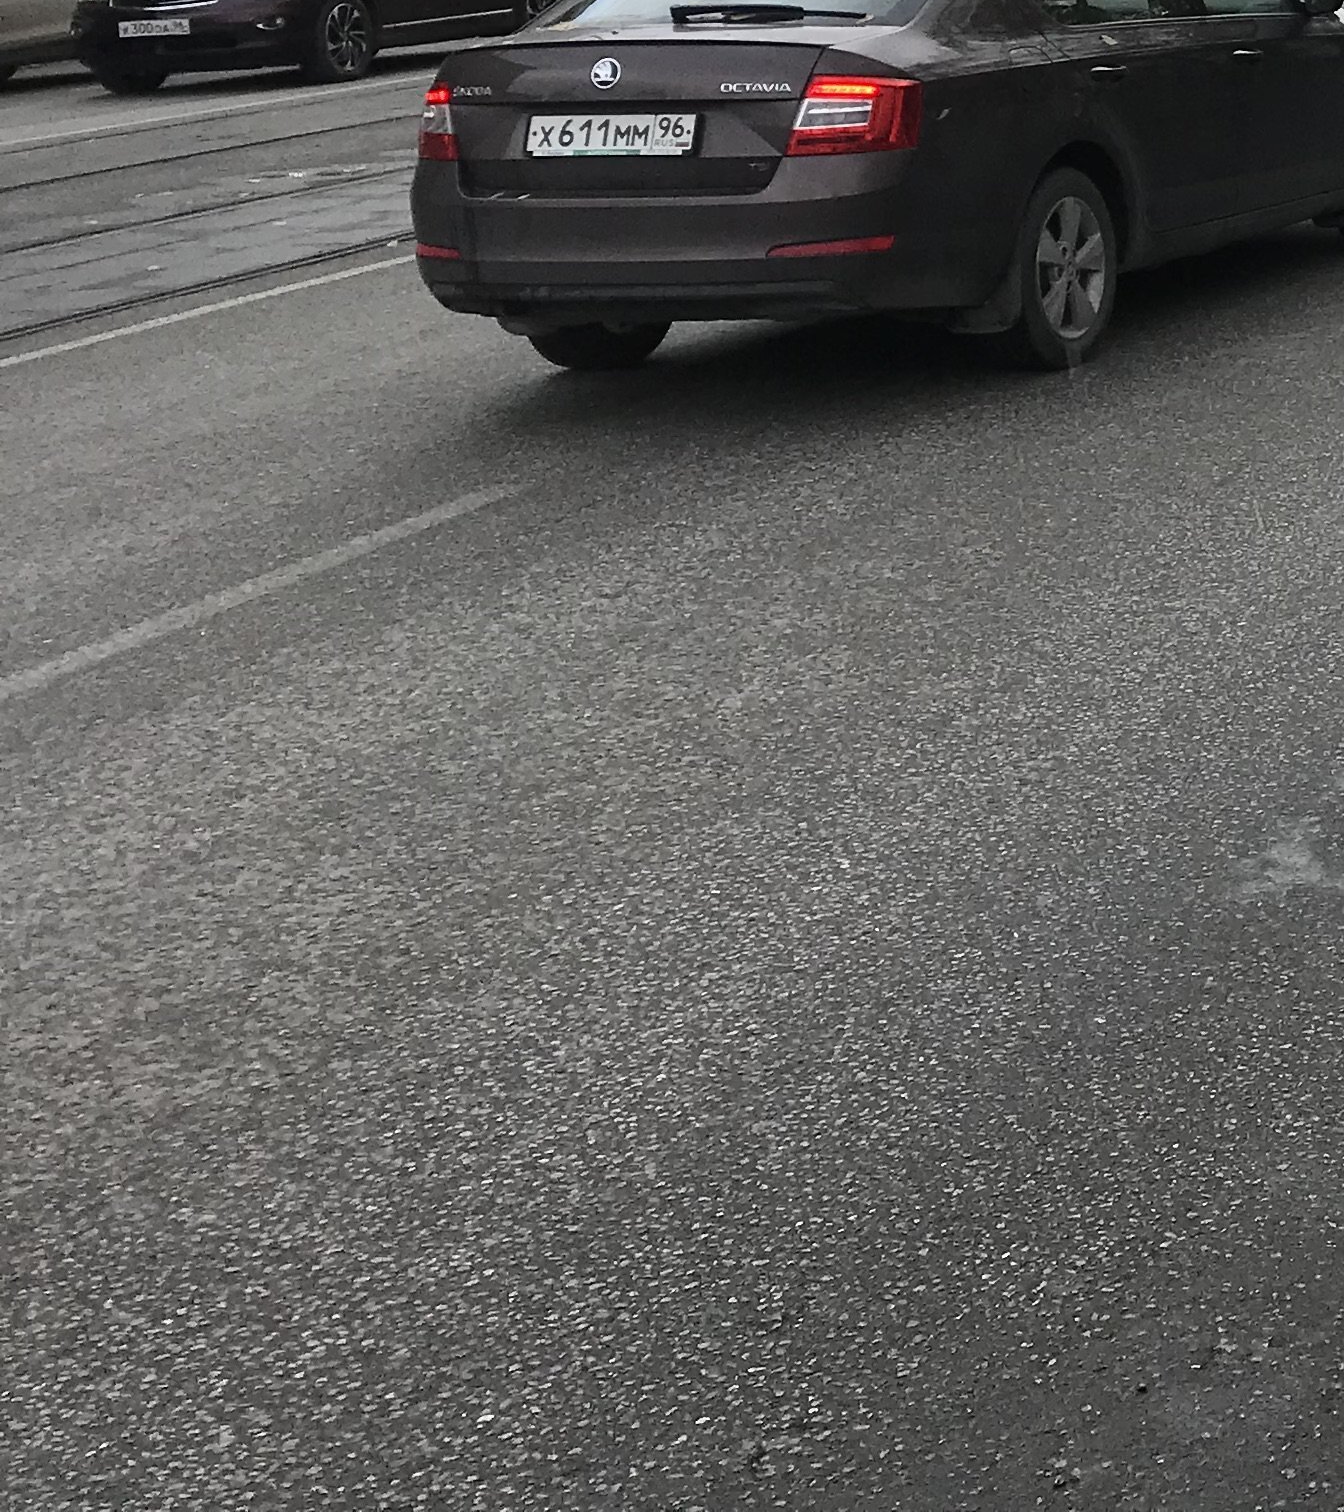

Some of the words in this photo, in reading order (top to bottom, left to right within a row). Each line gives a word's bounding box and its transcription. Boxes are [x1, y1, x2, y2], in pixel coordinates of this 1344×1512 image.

[720, 83, 791, 93] OCTAVIA
[658, 116, 685, 138] 96
[653, 139, 675, 147] RUS
